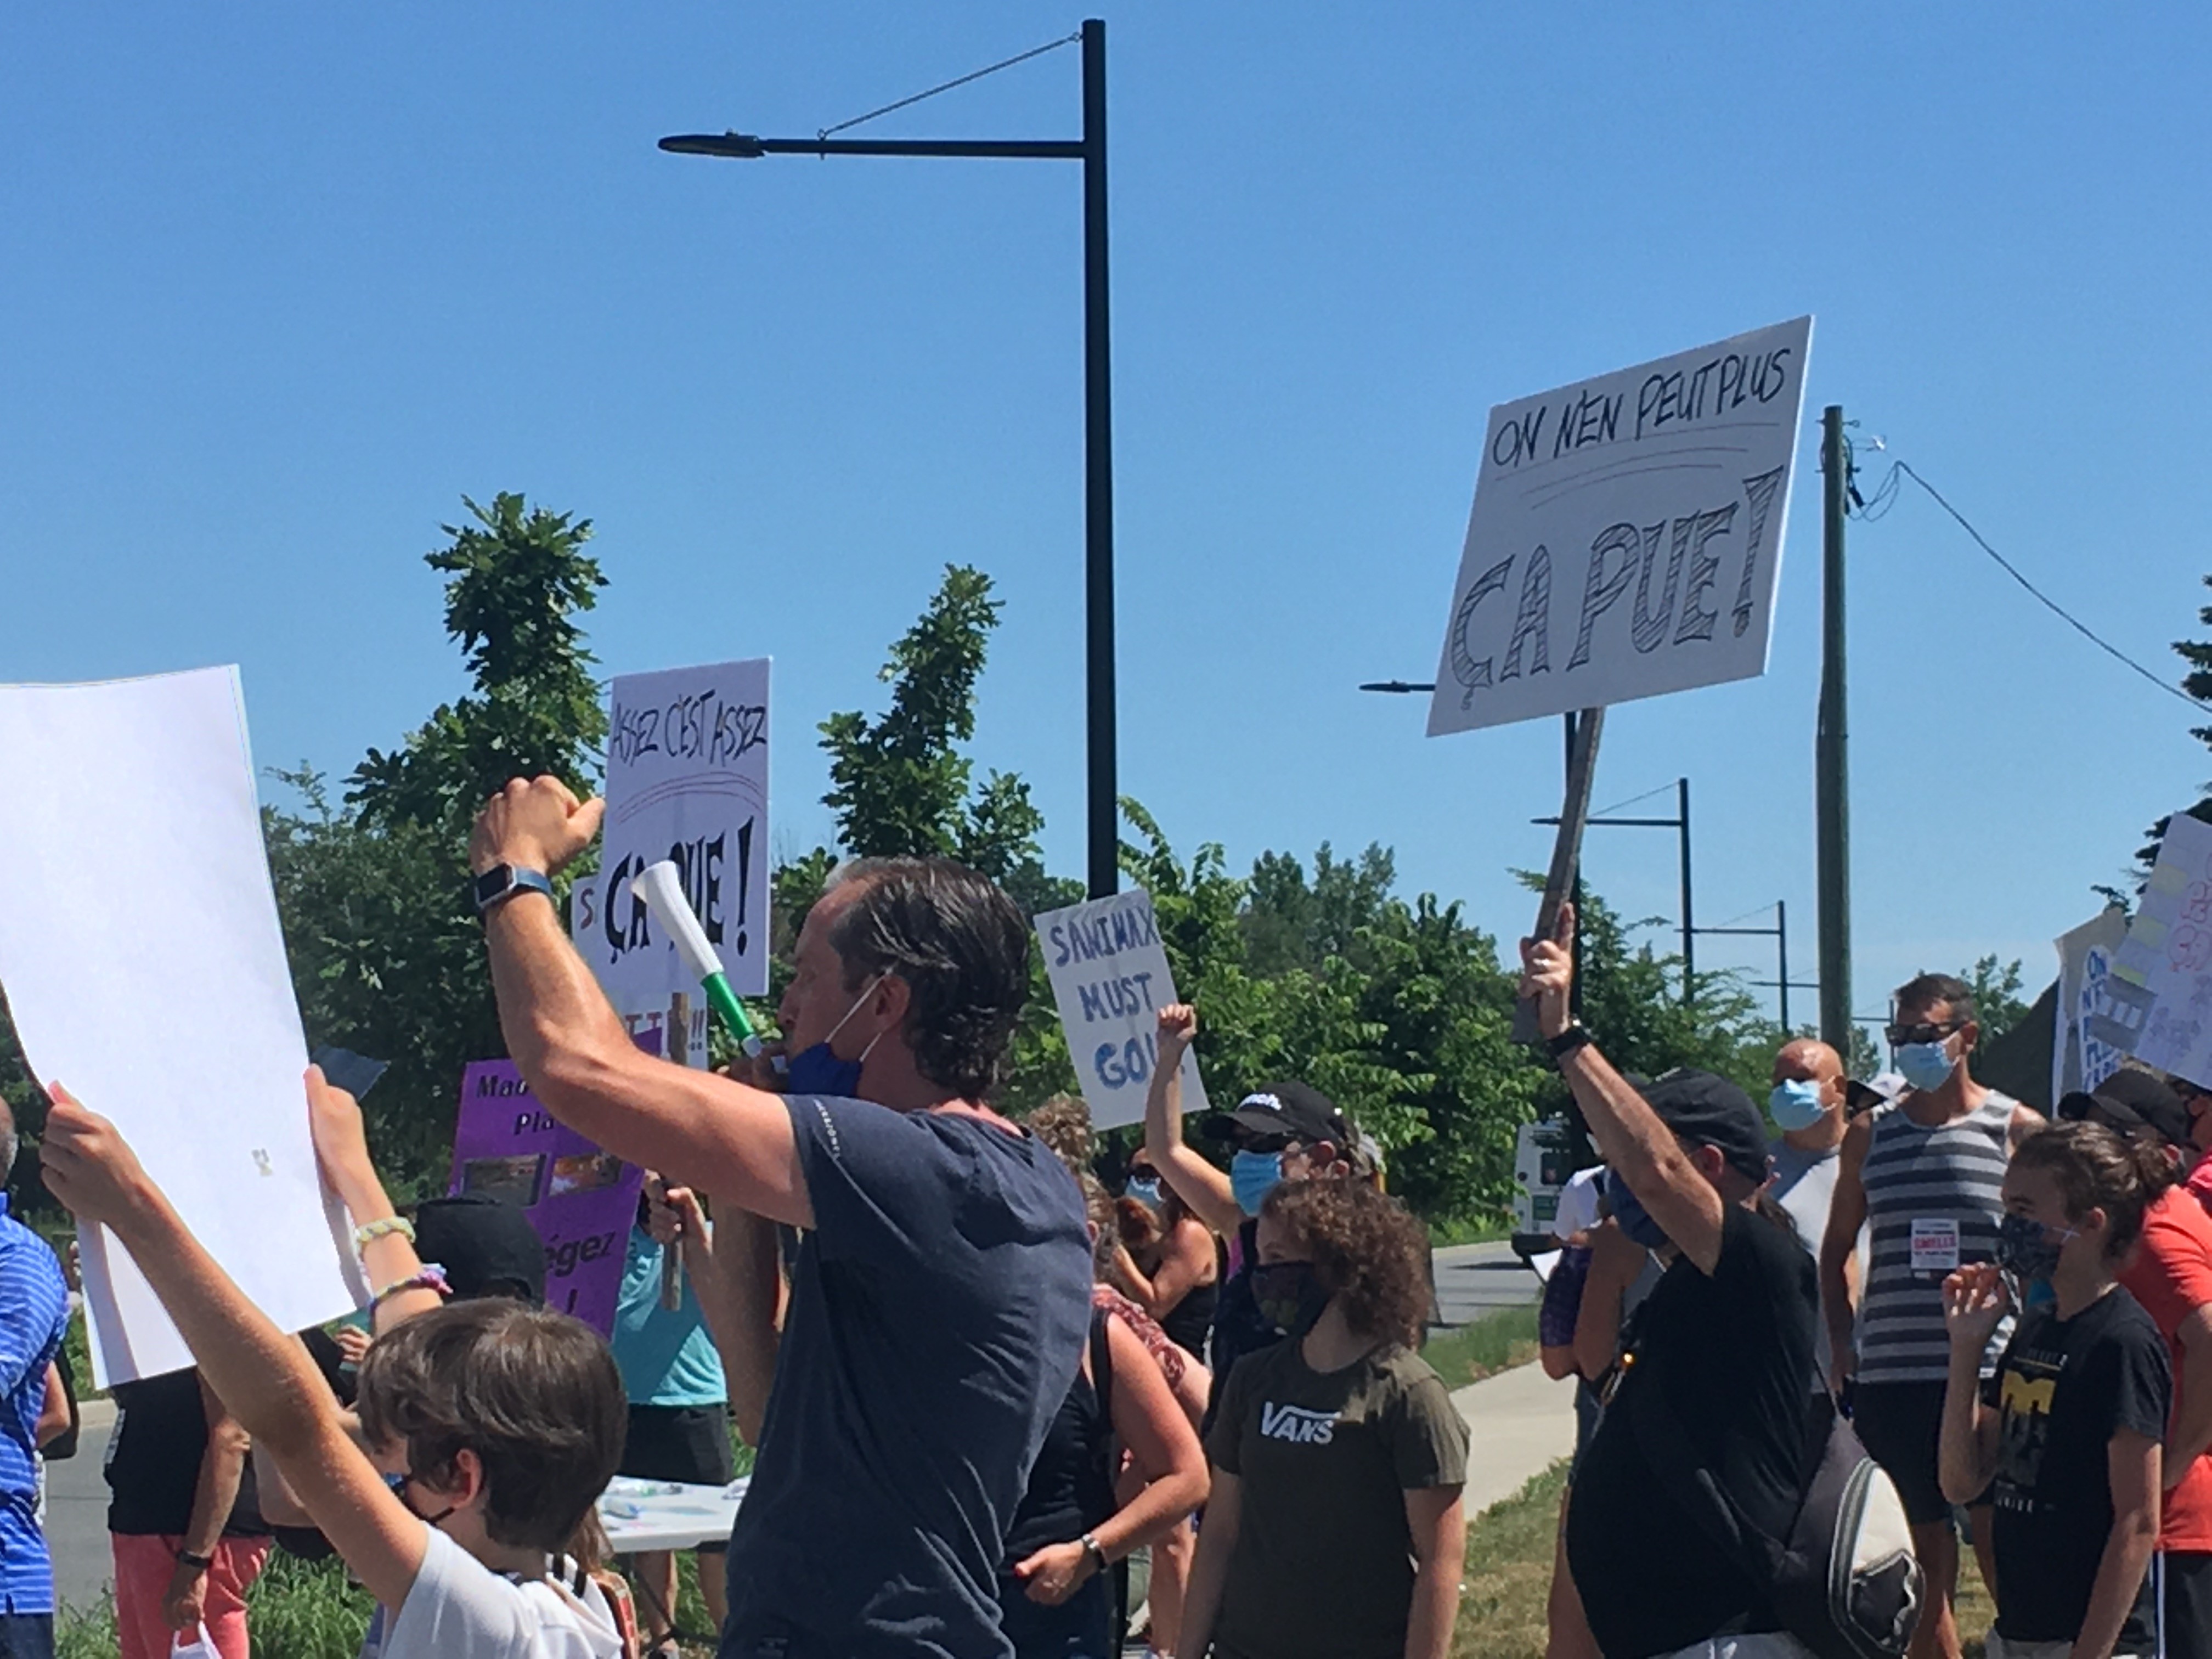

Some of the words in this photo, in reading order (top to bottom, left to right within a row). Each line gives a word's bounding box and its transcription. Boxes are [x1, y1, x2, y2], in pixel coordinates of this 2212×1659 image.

[1493, 406, 1547, 467] ON
[1452, 544, 1551, 710] ÇA
[611, 702, 659, 767] ASSEZ
[710, 700, 767, 767] ASSEZ
[1049, 904, 1160, 967] SANIMAX
[1077, 972, 1153, 1022] MUST
[1261, 1401, 1342, 1444] VANS
